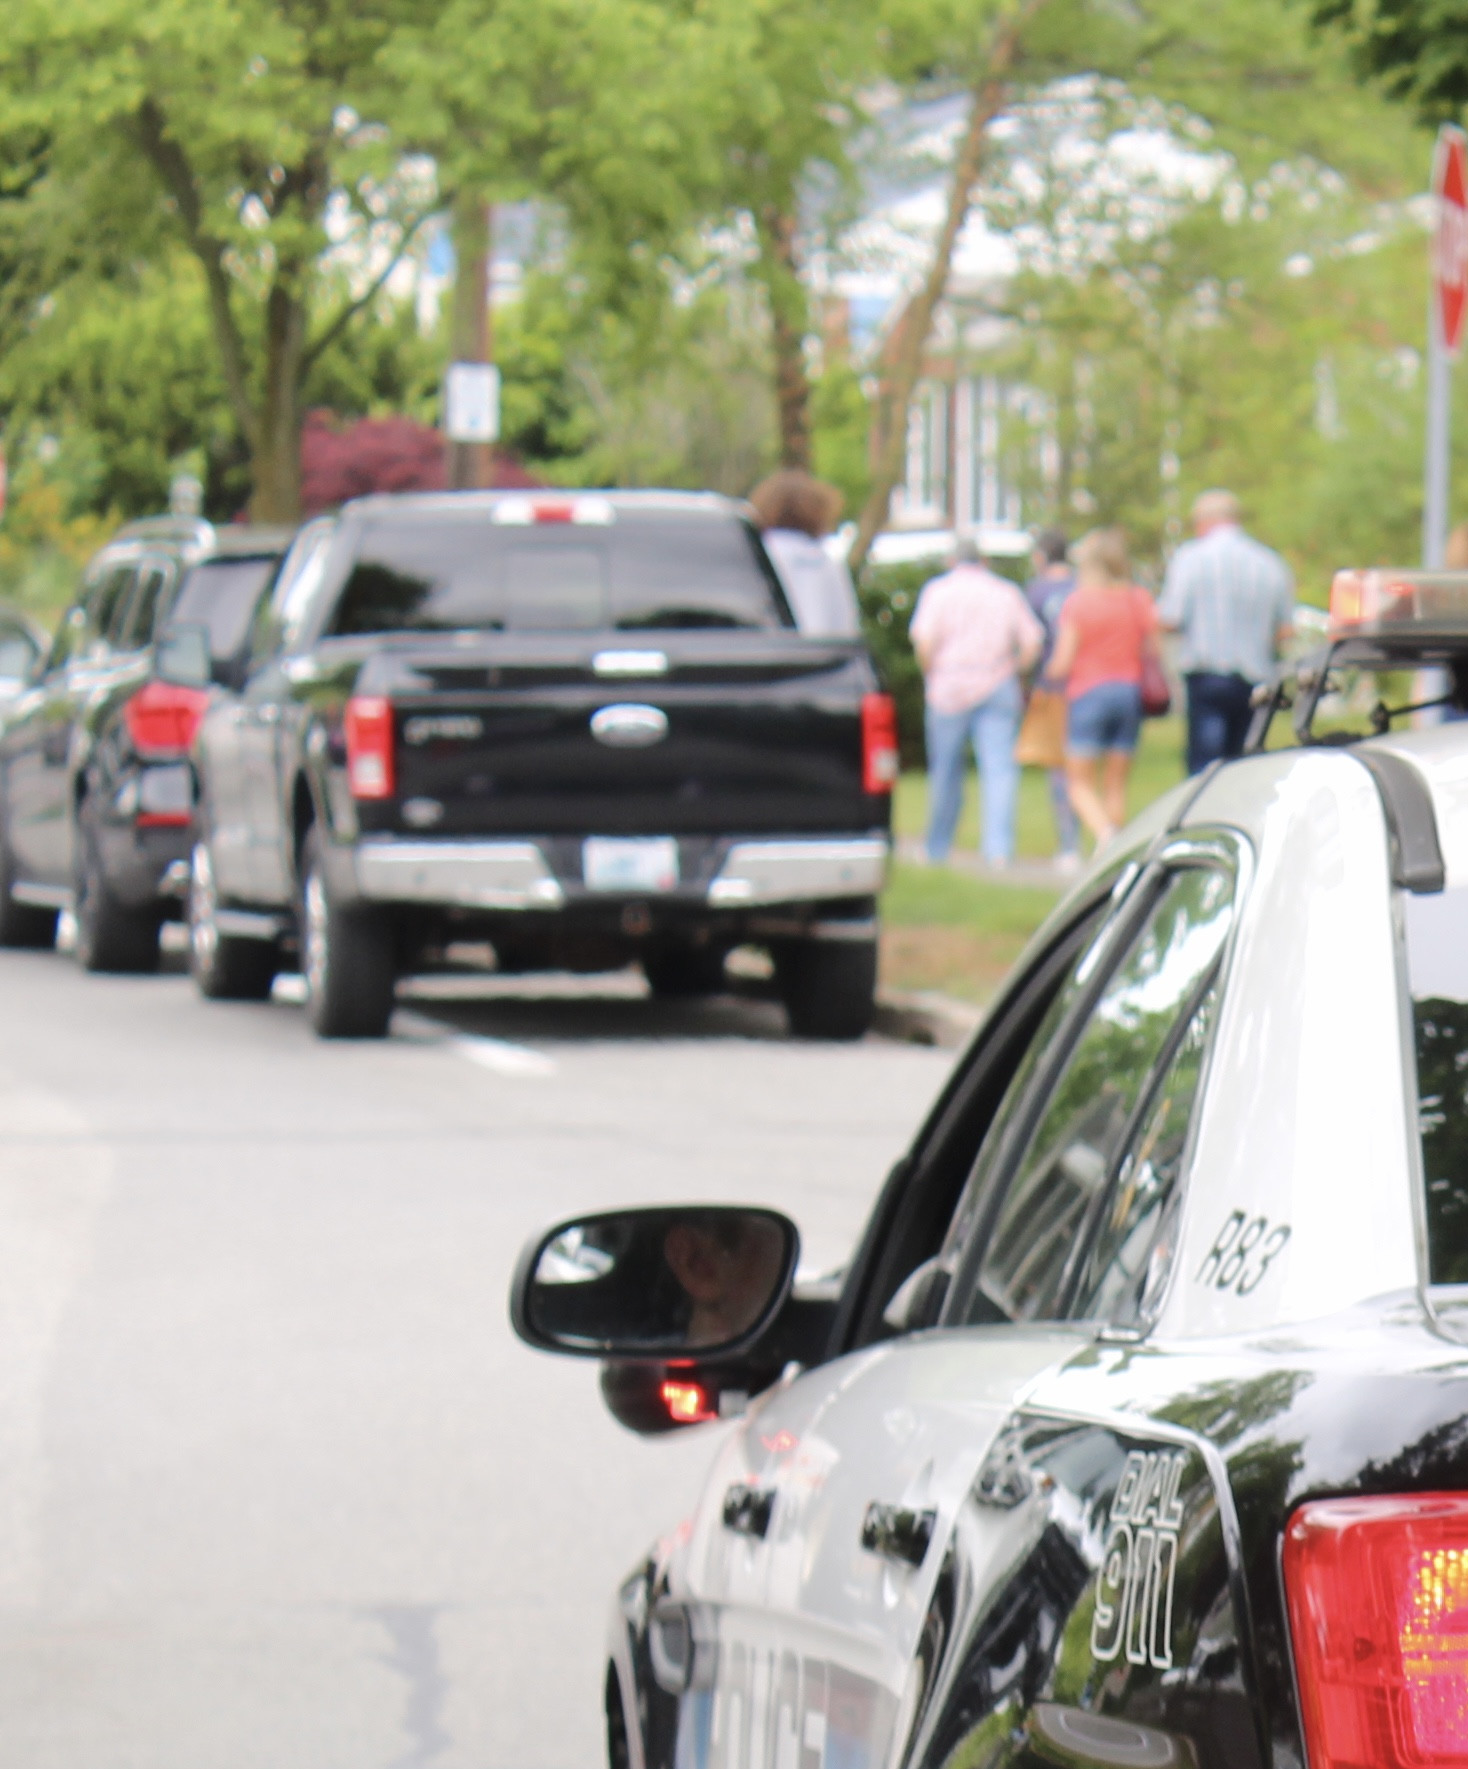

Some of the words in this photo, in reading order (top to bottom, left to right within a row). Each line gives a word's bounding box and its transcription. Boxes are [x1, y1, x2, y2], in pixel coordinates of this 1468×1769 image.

[1194, 1208, 1292, 1297] R83
[1109, 1449, 1186, 1531] DIAL
[1089, 1522, 1179, 1670] 911
